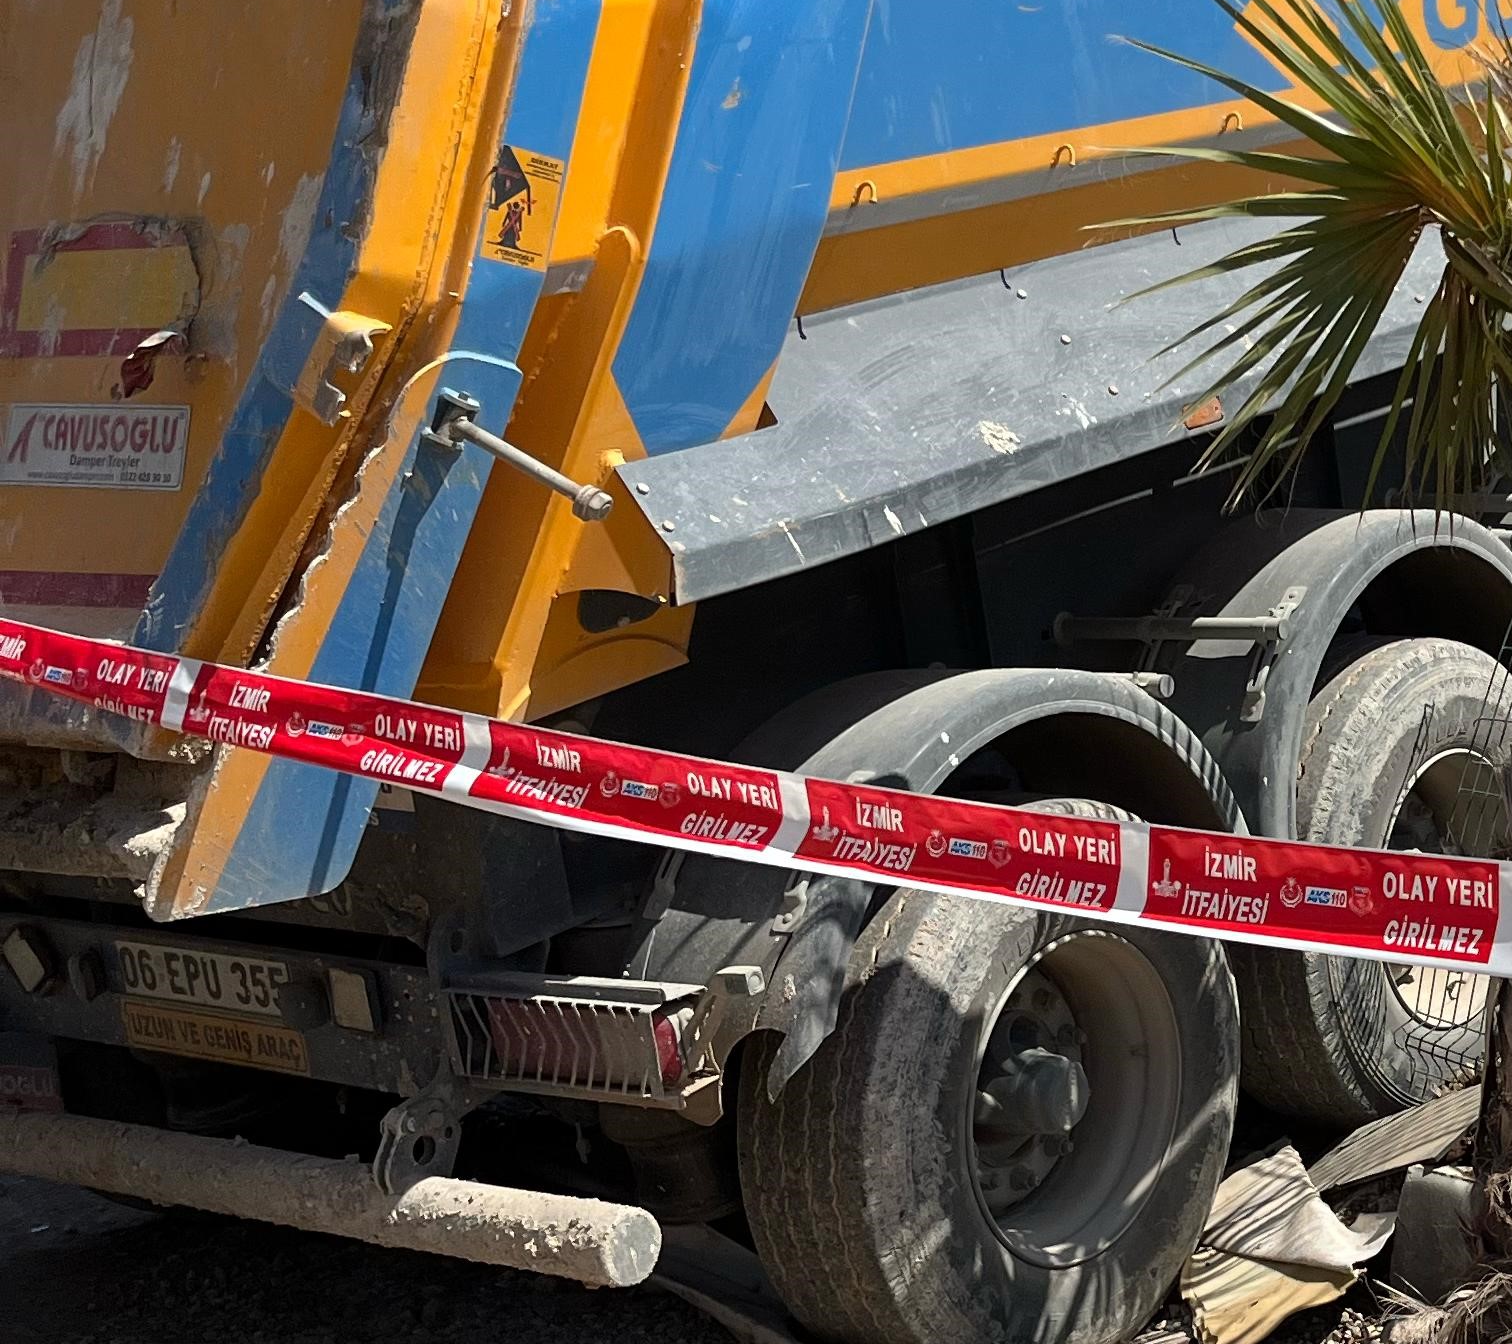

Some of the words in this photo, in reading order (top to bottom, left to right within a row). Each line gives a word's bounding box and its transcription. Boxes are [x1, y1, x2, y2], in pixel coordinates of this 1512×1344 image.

[97, 659, 135, 686] OLAY
[138, 665, 172, 693] YERİ
[229, 681, 271, 713] İZMİR
[208, 711, 277, 750] İTFAİYESİ
[375, 714, 418, 743] OLAY
[423, 721, 461, 751] YERİ
[360, 748, 445, 783] GİRİLMEZ
[535, 738, 582, 774] İZMİR
[506, 770, 591, 809] İTFAİYESİ
[687, 772, 732, 801] OLAY
[738, 781, 778, 810] YERİ
[680, 809, 768, 844] GİRİLMEZ
[856, 796, 904, 832] İZMİR
[833, 829, 917, 872] İTFAİYESİ
[1019, 827, 1066, 858] OLAY
[1073, 834, 1116, 865] YERİ
[1204, 845, 1257, 882] İZMİR
[1015, 868, 1106, 907] GİRİLMEZ
[1181, 883, 1270, 925] İTFAİYESİ
[1382, 871, 1438, 903] OLAY
[1446, 874, 1493, 909] YERİ
[1383, 914, 1484, 956] GİRİLMEZ
[119, 947, 157, 991] 06
[164, 952, 222, 1001] EPU
[230, 962, 283, 1007] 355
[177, 1020, 200, 1045] VE
